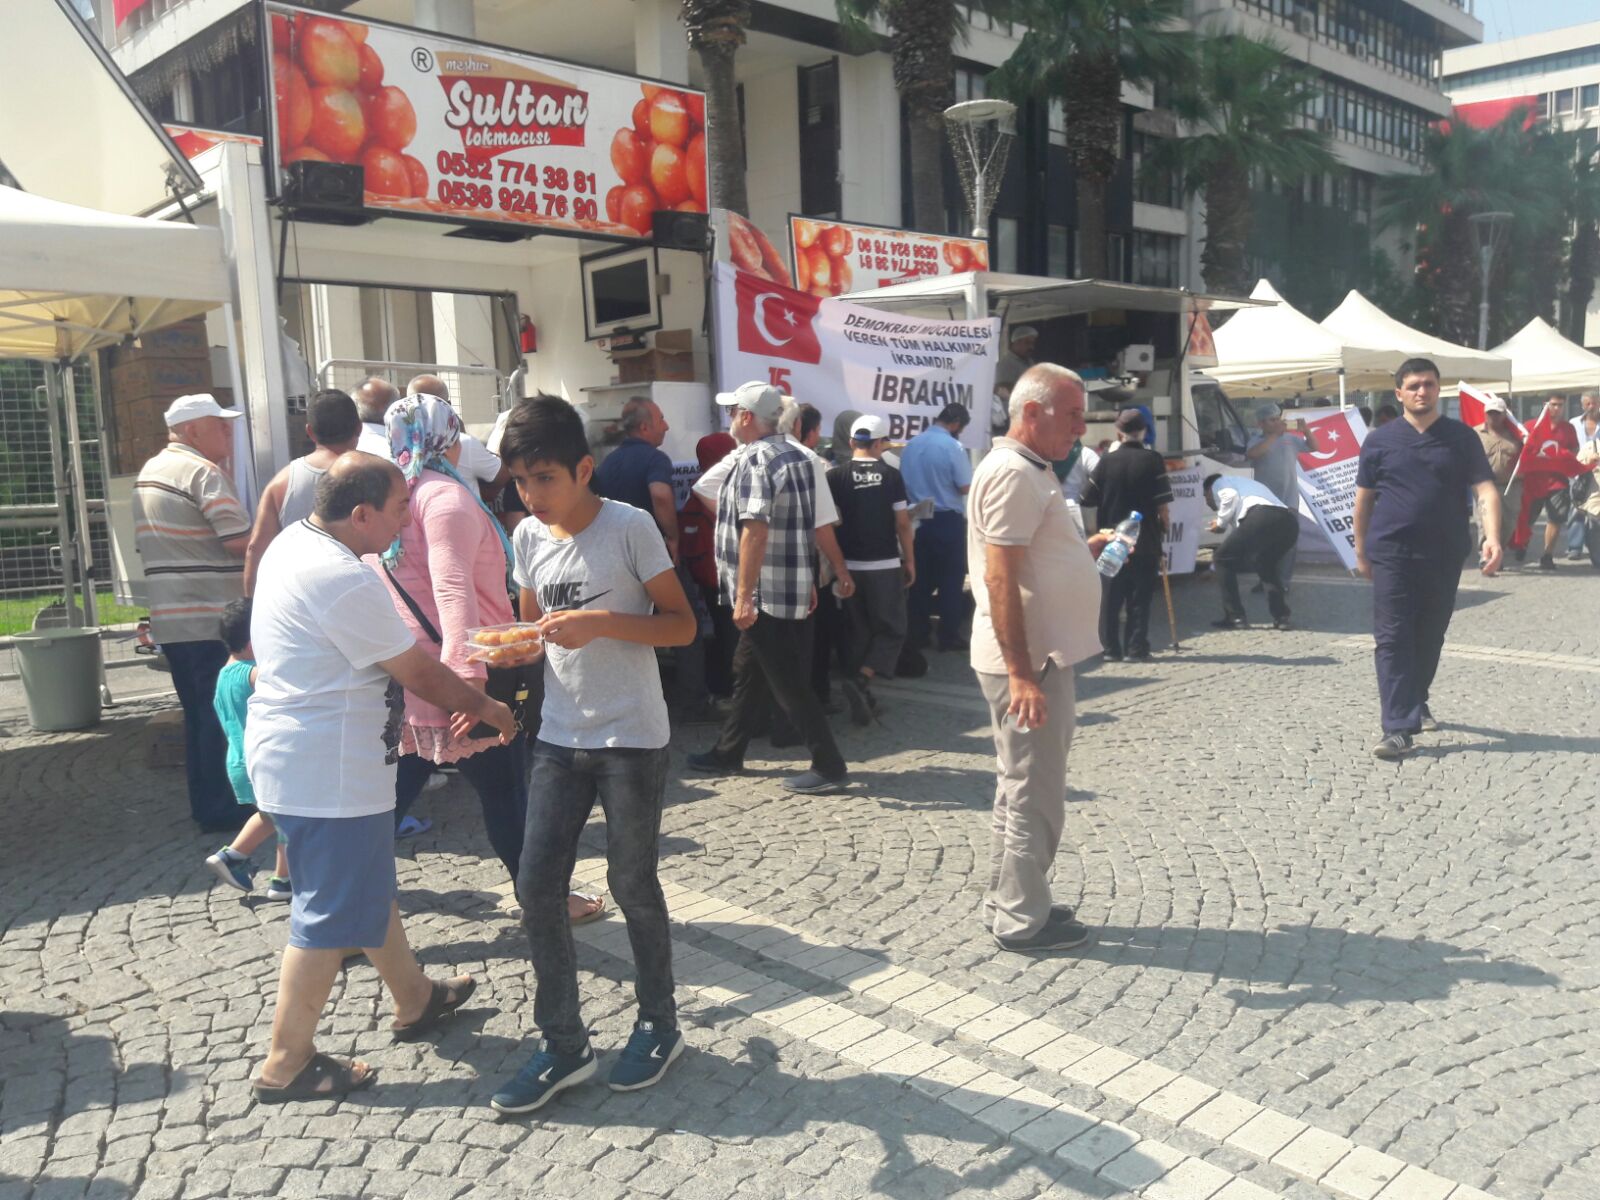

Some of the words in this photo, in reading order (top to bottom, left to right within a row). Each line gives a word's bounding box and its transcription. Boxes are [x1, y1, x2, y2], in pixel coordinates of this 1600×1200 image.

[445, 79, 588, 130] Sultan
[465, 127, 551, 147] lokmacısı
[437, 151, 493, 179] 0532
[497, 159, 538, 186] 774
[543, 166, 569, 190] 38
[574, 170, 597, 194] 81
[437, 179, 493, 208] 0536
[498, 187, 538, 214] 924
[542, 192, 568, 218] 76
[573, 198, 598, 221] 90
[843, 329, 889, 347] VEREN
[889, 335, 920, 351] TÜM
[921, 340, 988, 356] HALKIMIZA
[872, 367, 974, 410] İBRAHİM
[543, 581, 583, 607] NIKE
